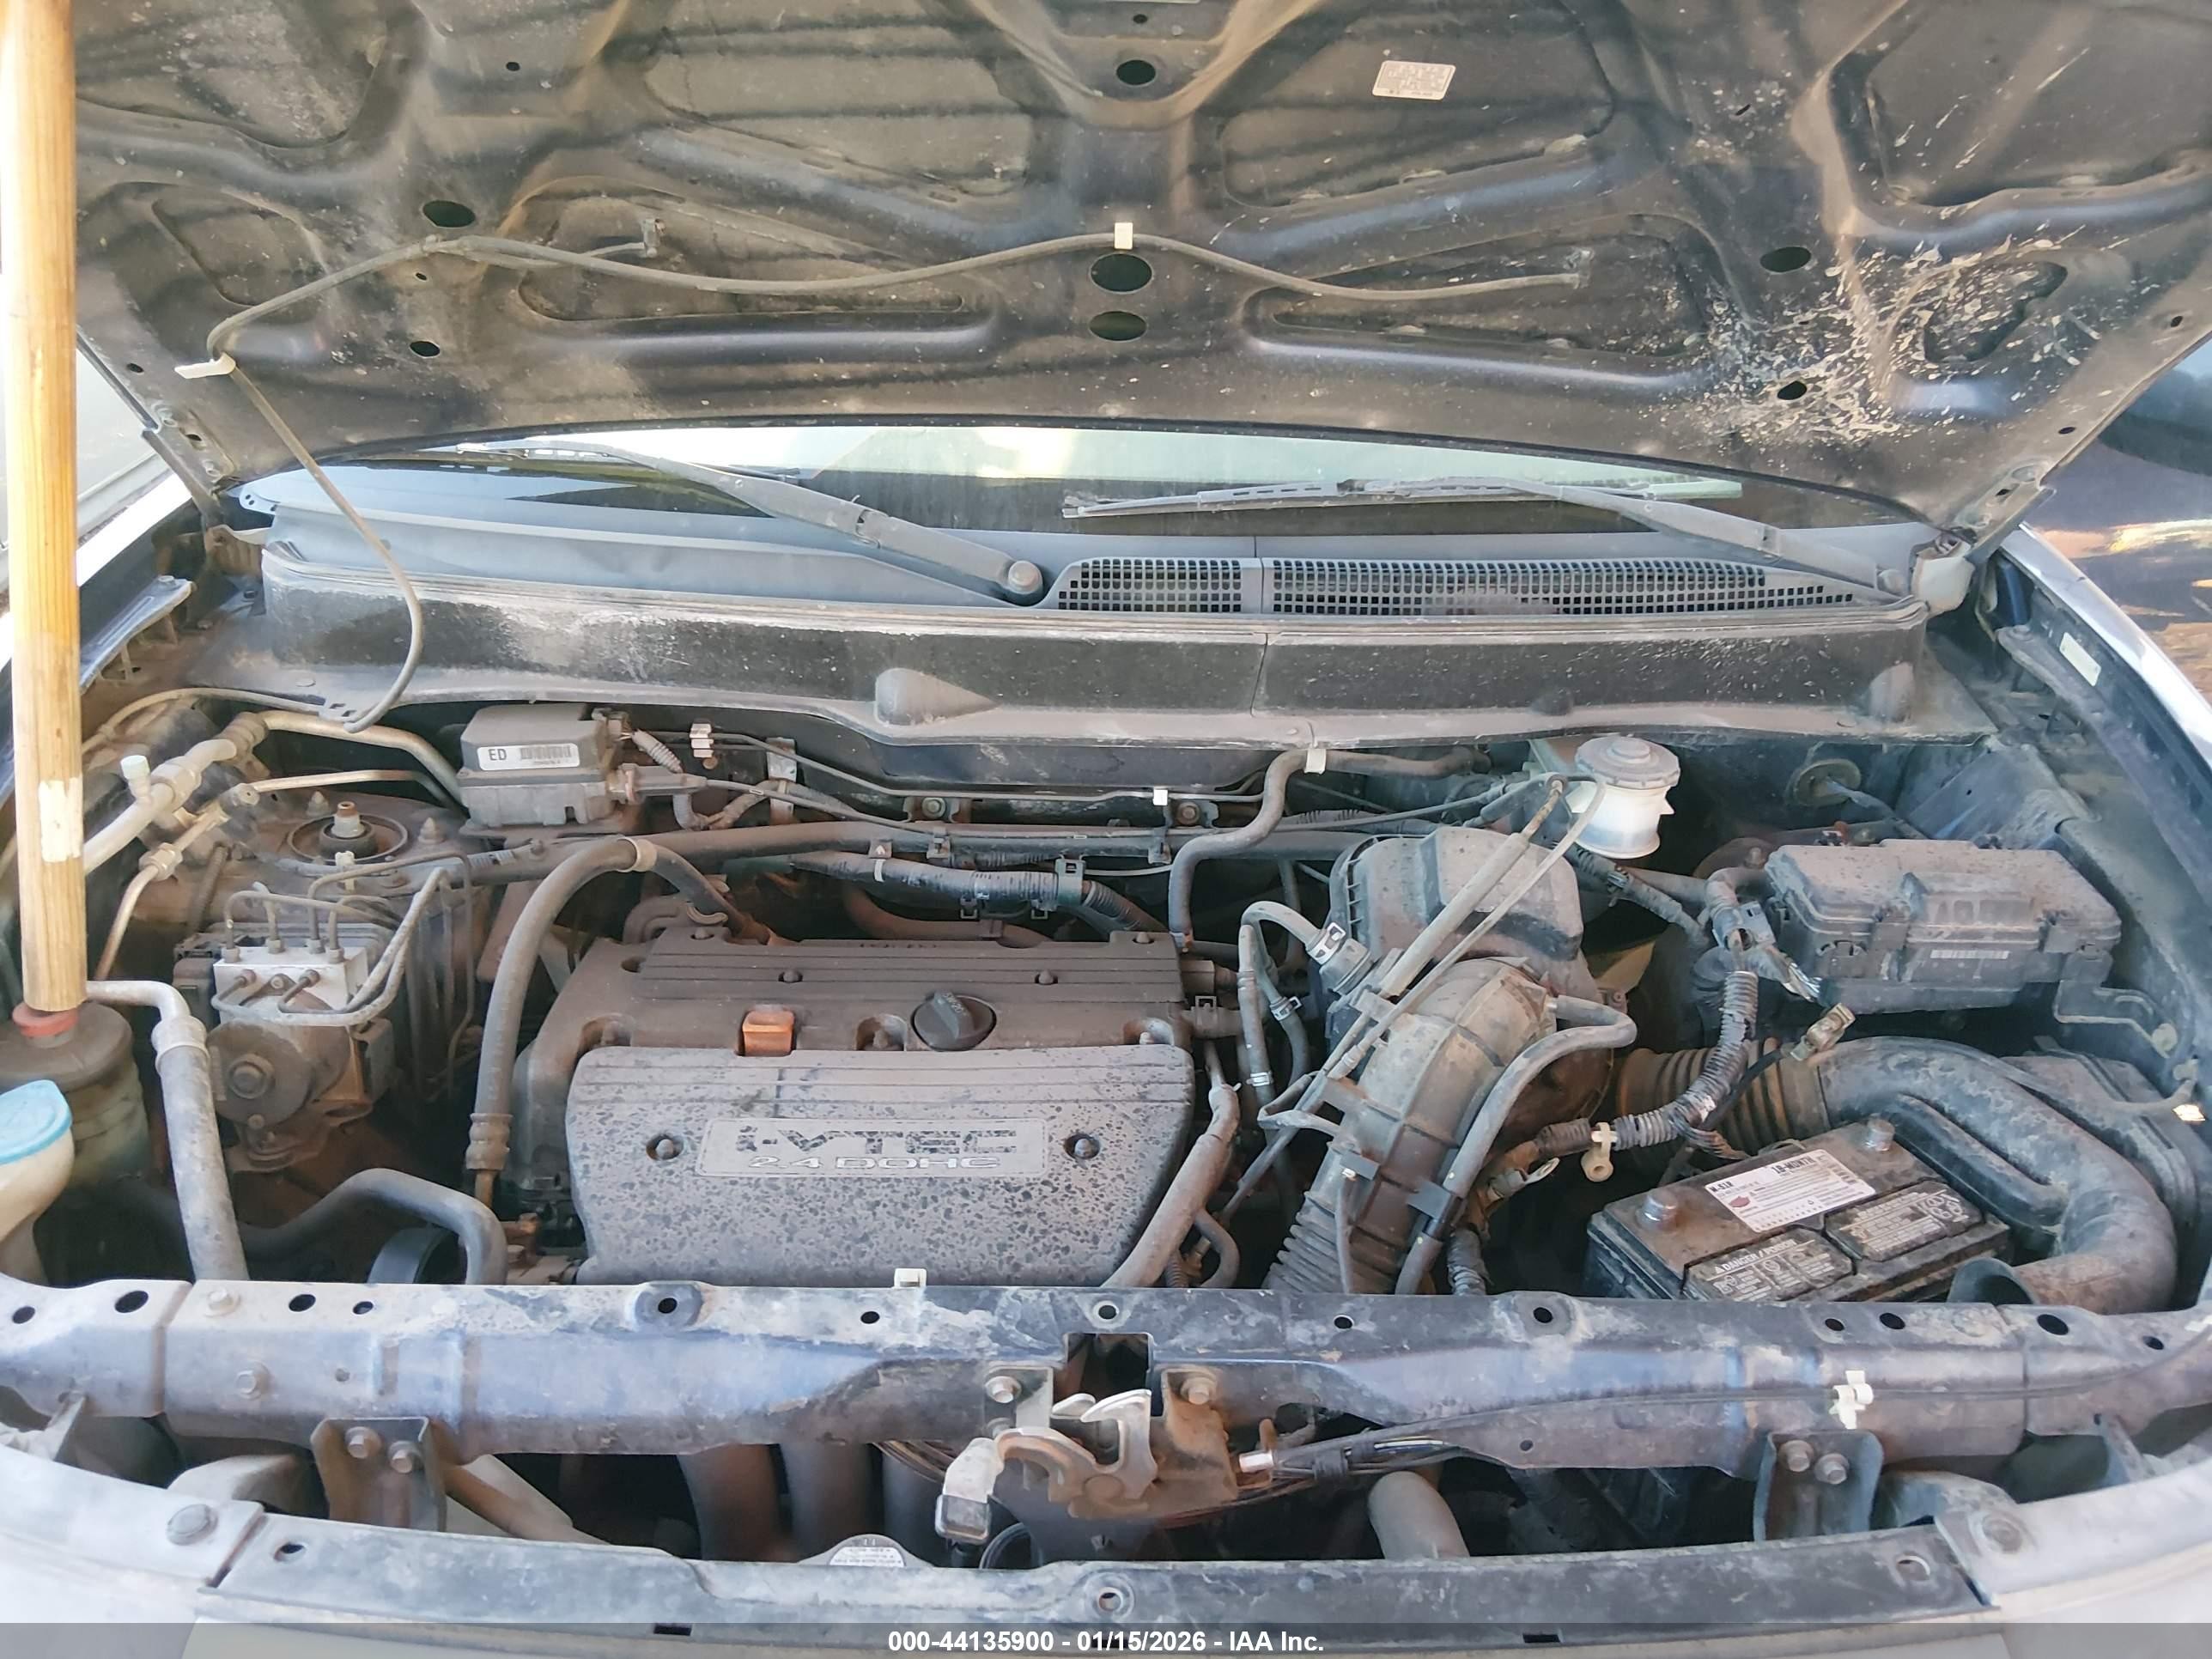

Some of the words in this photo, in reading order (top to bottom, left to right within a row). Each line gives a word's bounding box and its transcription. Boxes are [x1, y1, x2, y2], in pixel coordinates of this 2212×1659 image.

[488, 748, 507, 761] ED
[748, 1156, 823, 1169] 2.4
[835, 1156, 1001, 1170] DOHC
[1721, 1254, 1759, 1271] DANGER
